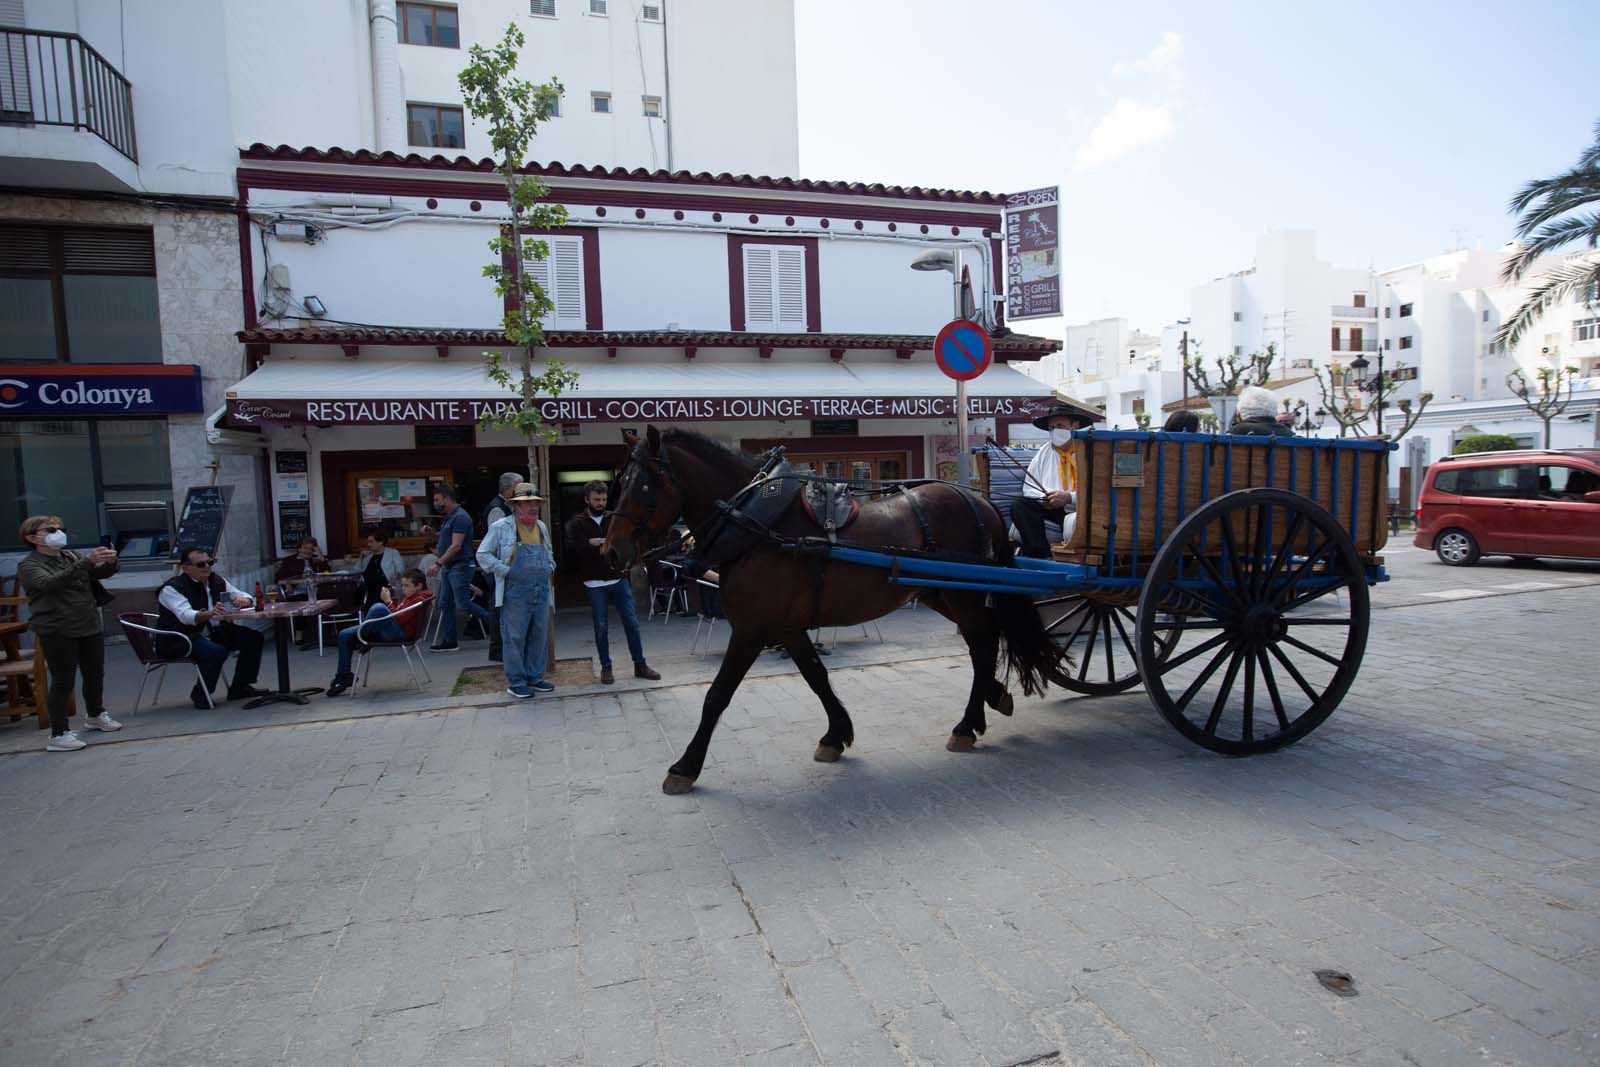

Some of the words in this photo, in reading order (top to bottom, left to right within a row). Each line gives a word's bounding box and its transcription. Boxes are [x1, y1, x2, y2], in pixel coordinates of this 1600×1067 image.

[1027, 190, 1057, 205] OPEN
[1008, 214, 1022, 315] RESTAURANT
[1031, 282, 1056, 294] GRILL
[38, 381, 153, 409] Colonya
[307, 401, 459, 421] RESTAURANTE
[541, 401, 596, 420] GRILL
[606, 400, 714, 418] COCKTAILS
[723, 399, 803, 417] LOUNGE
[810, 399, 884, 416] TERRACE
[891, 398, 944, 415] MUSIC
